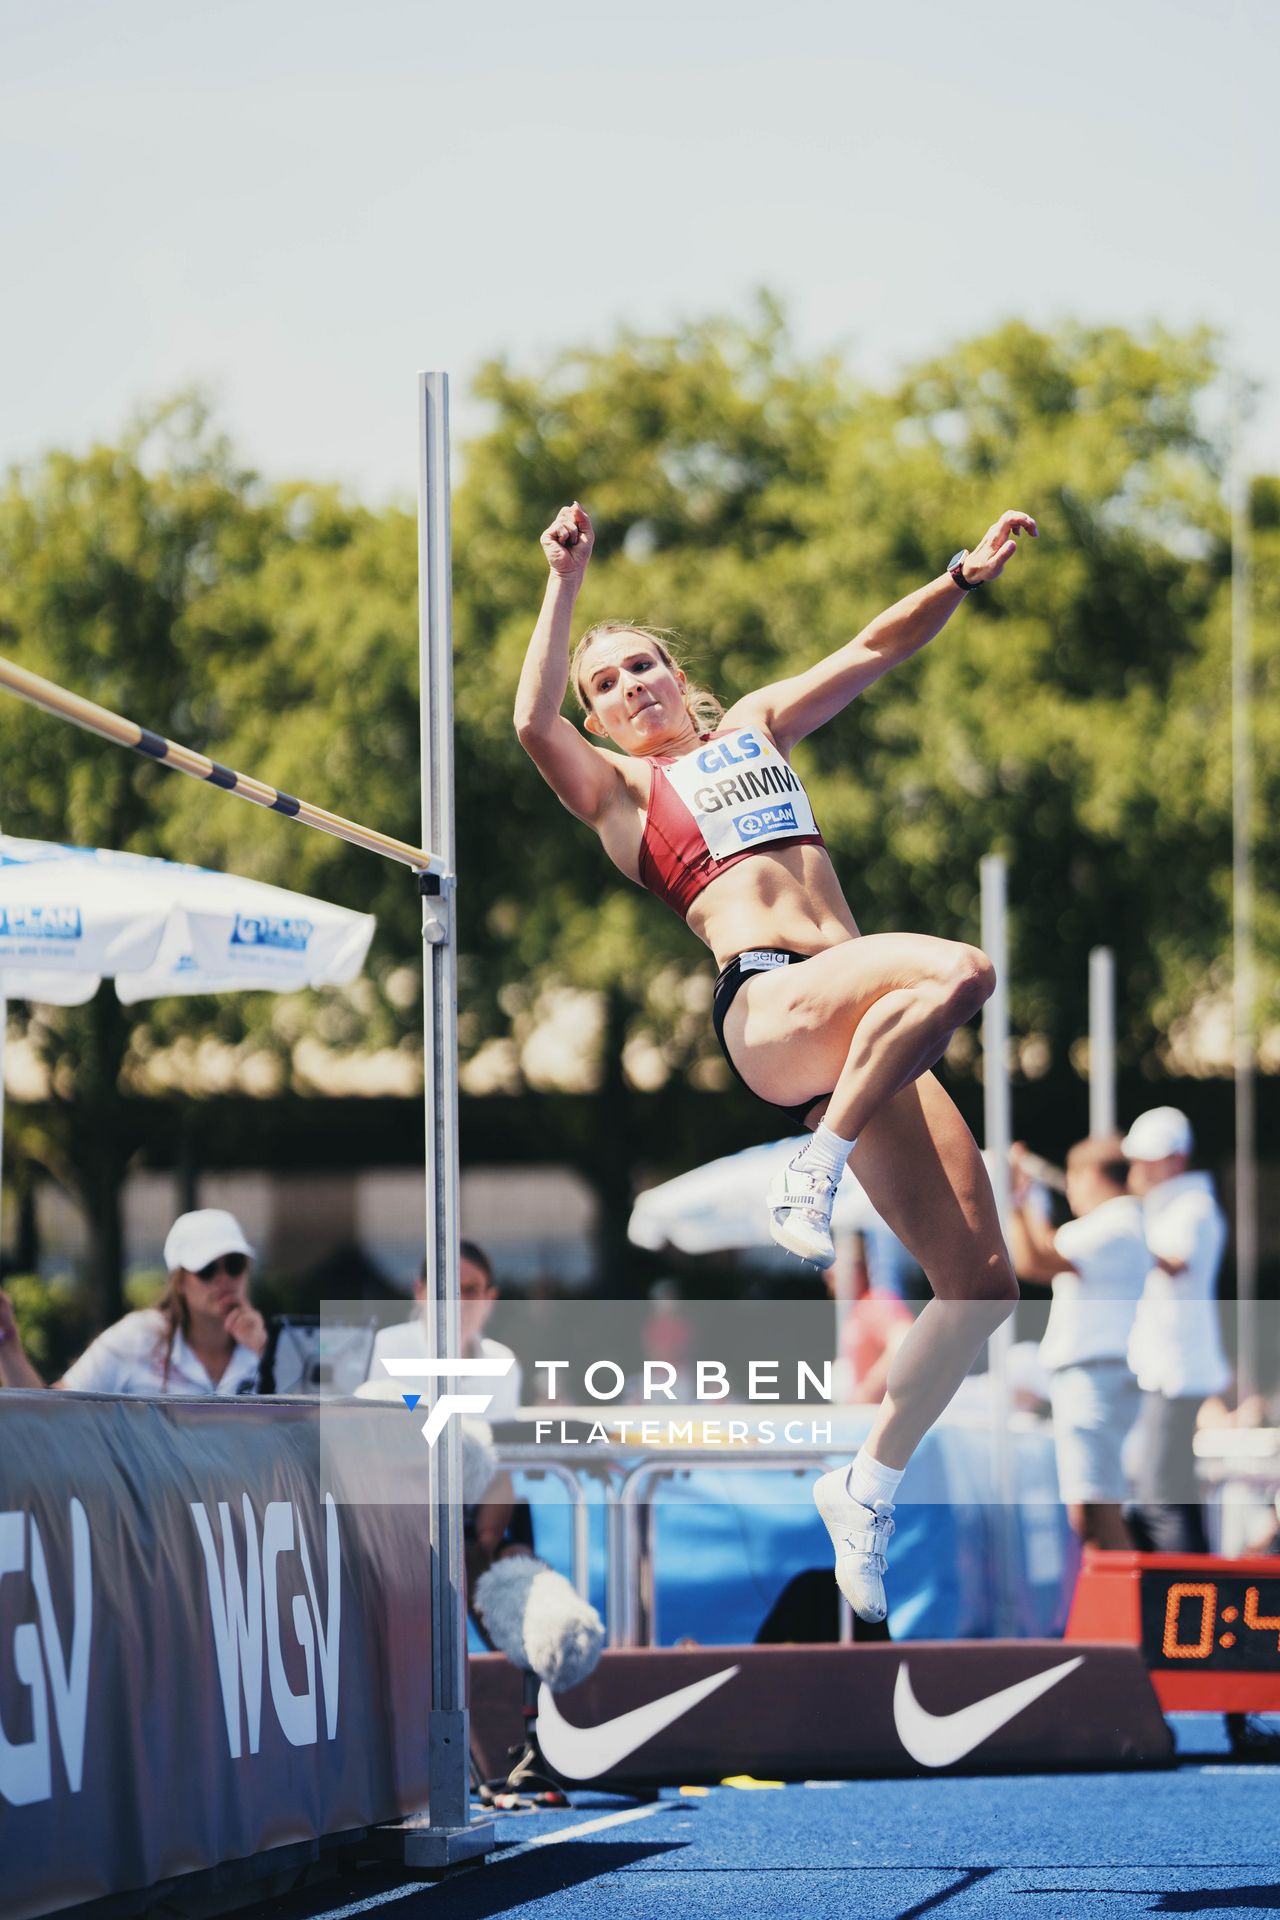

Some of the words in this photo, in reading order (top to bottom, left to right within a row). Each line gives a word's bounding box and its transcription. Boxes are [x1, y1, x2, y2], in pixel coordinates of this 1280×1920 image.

[696, 733, 761, 774] GLS
[693, 765, 800, 814] GRIMM
[761, 808, 794, 825] PLAN
[9, 906, 76, 929] PLAN
[783, 1195, 815, 1204] PUMA
[190, 1492, 341, 1758] WGV
